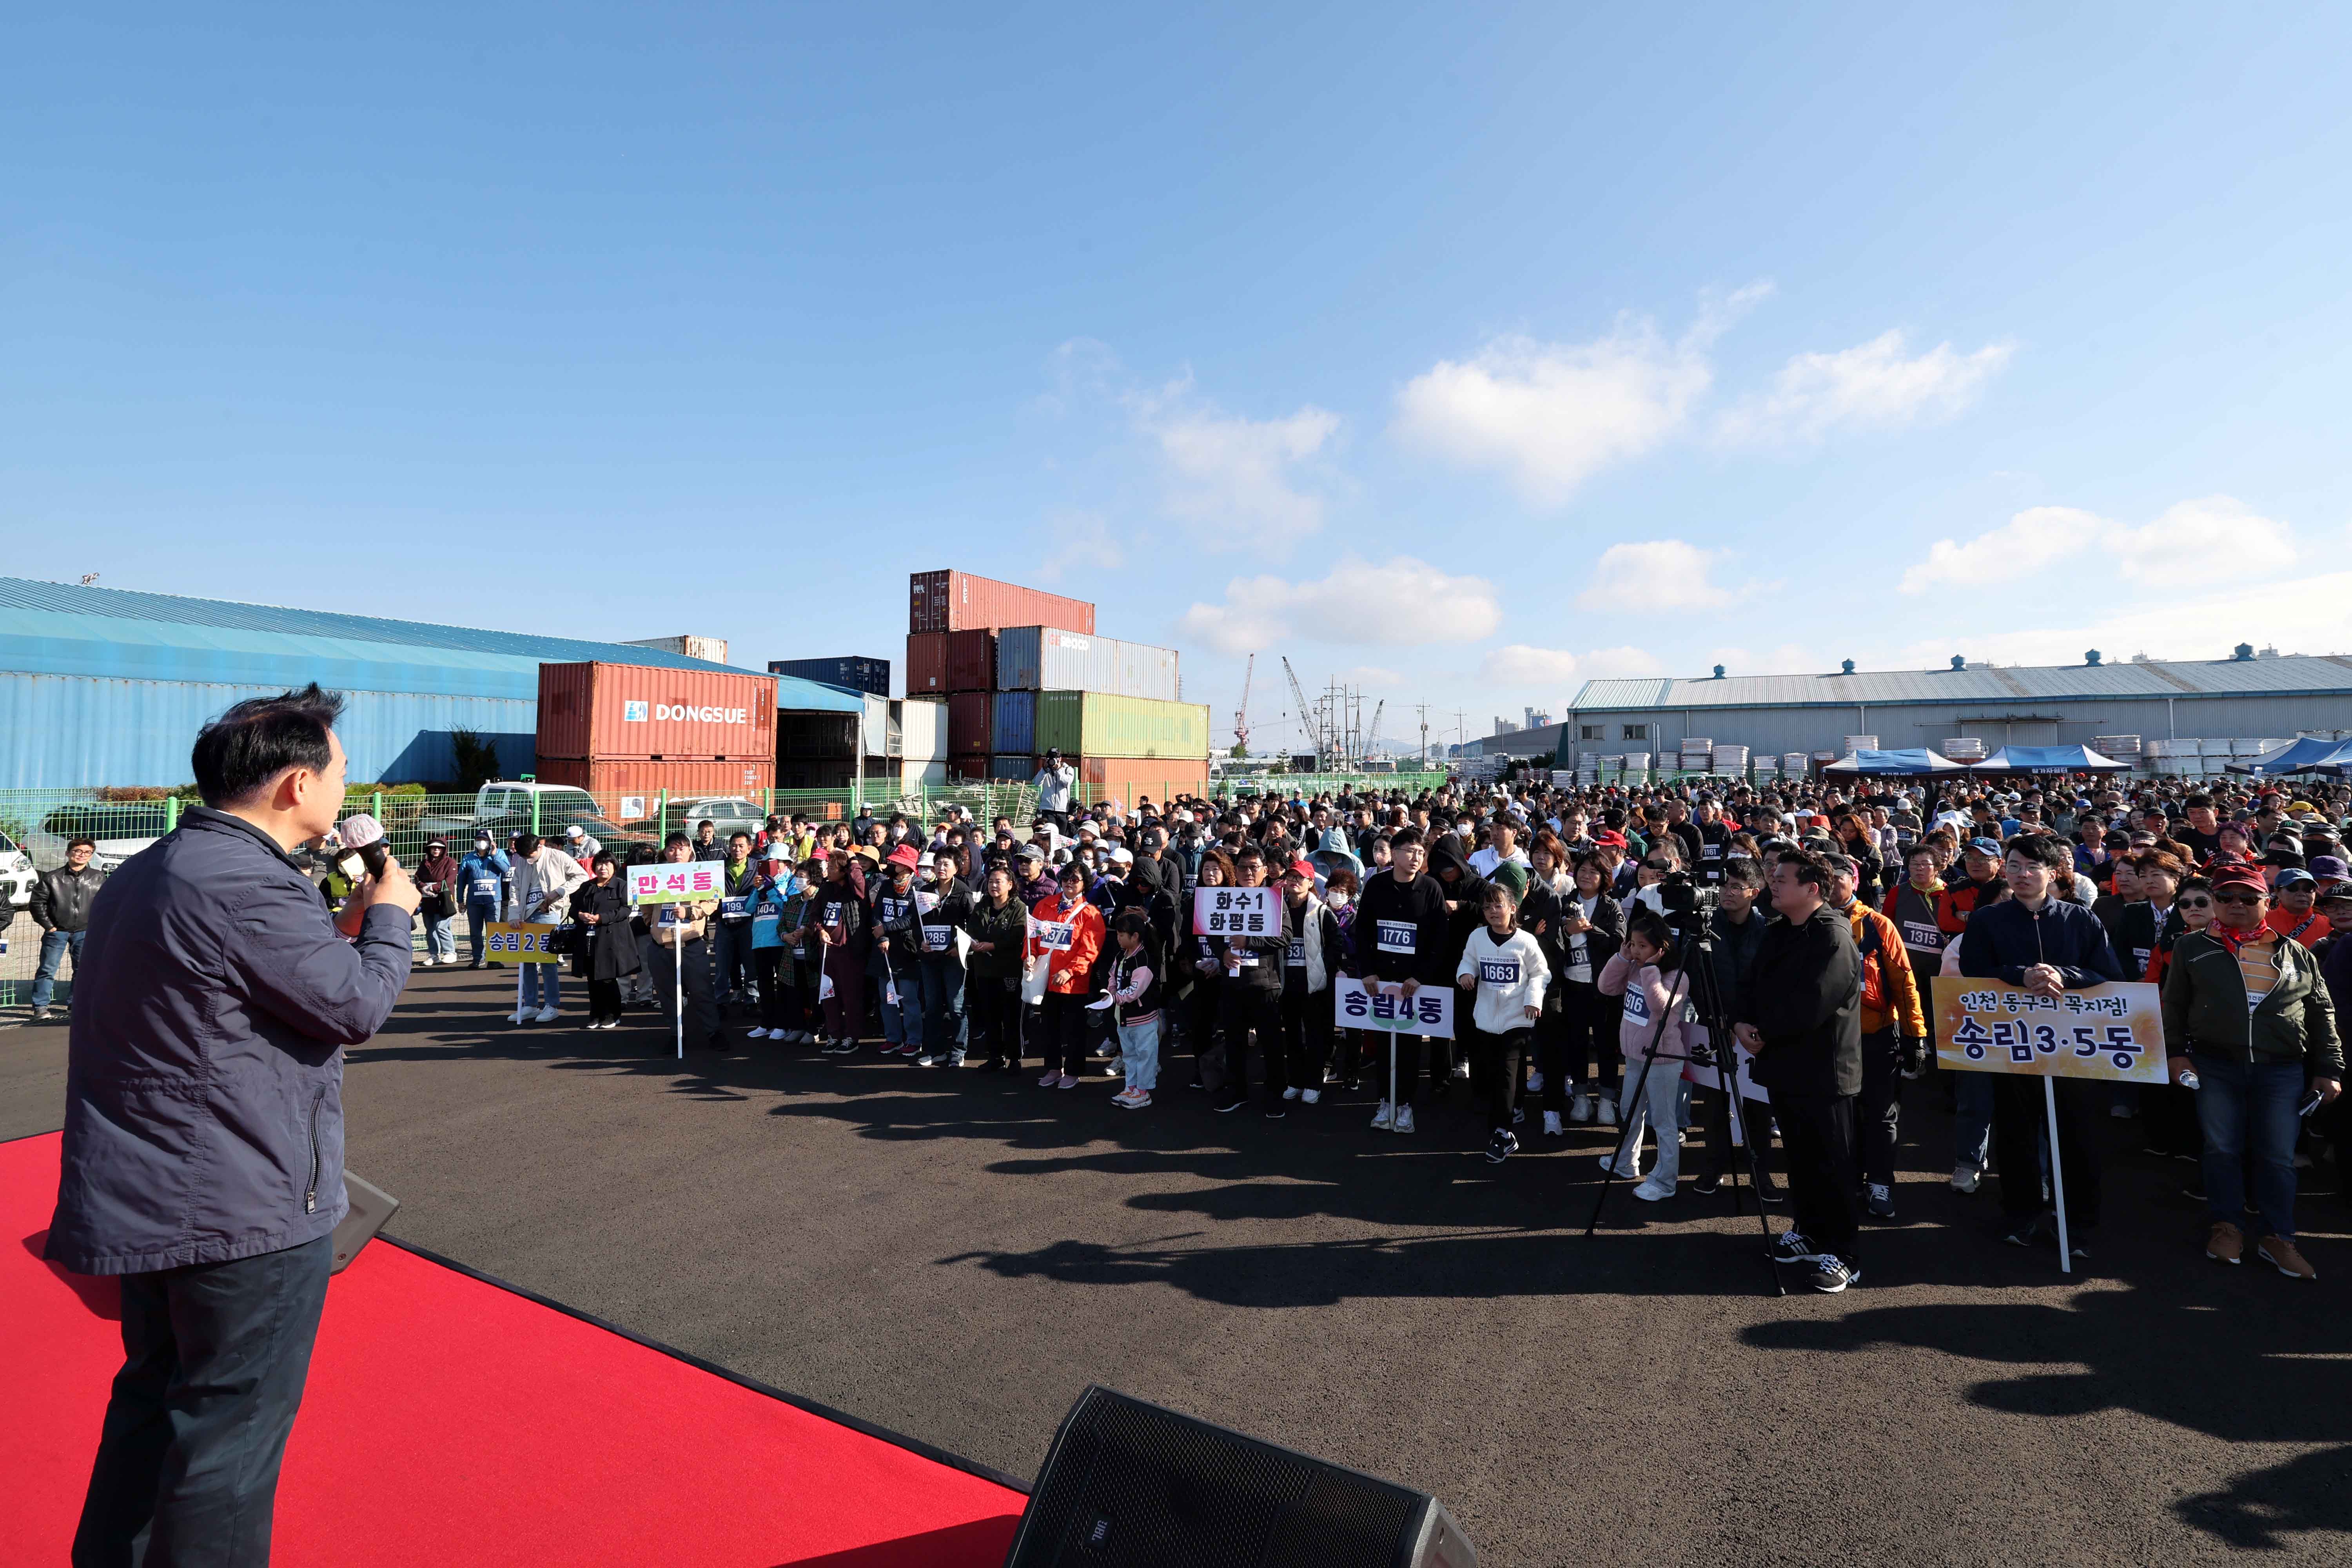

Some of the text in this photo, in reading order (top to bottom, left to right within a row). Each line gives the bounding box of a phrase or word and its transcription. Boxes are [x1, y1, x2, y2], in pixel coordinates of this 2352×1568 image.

[656, 704, 746, 724] DONGSUE
[726, 902, 744, 911] 199
[1216, 891, 1263, 910] 화수1
[757, 904, 775, 915] 1404
[884, 905, 903, 916] 190
[1209, 912, 1264, 932] 화평동
[1383, 929, 1410, 944] 1776
[1910, 930, 1937, 945] 1315
[1287, 945, 1305, 957] 631
[1570, 949, 1588, 963] 191
[1484, 965, 1514, 980] 1663
[1345, 991, 1442, 1024] 송림4동
[1624, 991, 1643, 1012] 1916
[1961, 993, 2127, 1016] 인천 동구의 꼭지점!
[1091, 1521, 1106, 1540] JBL
